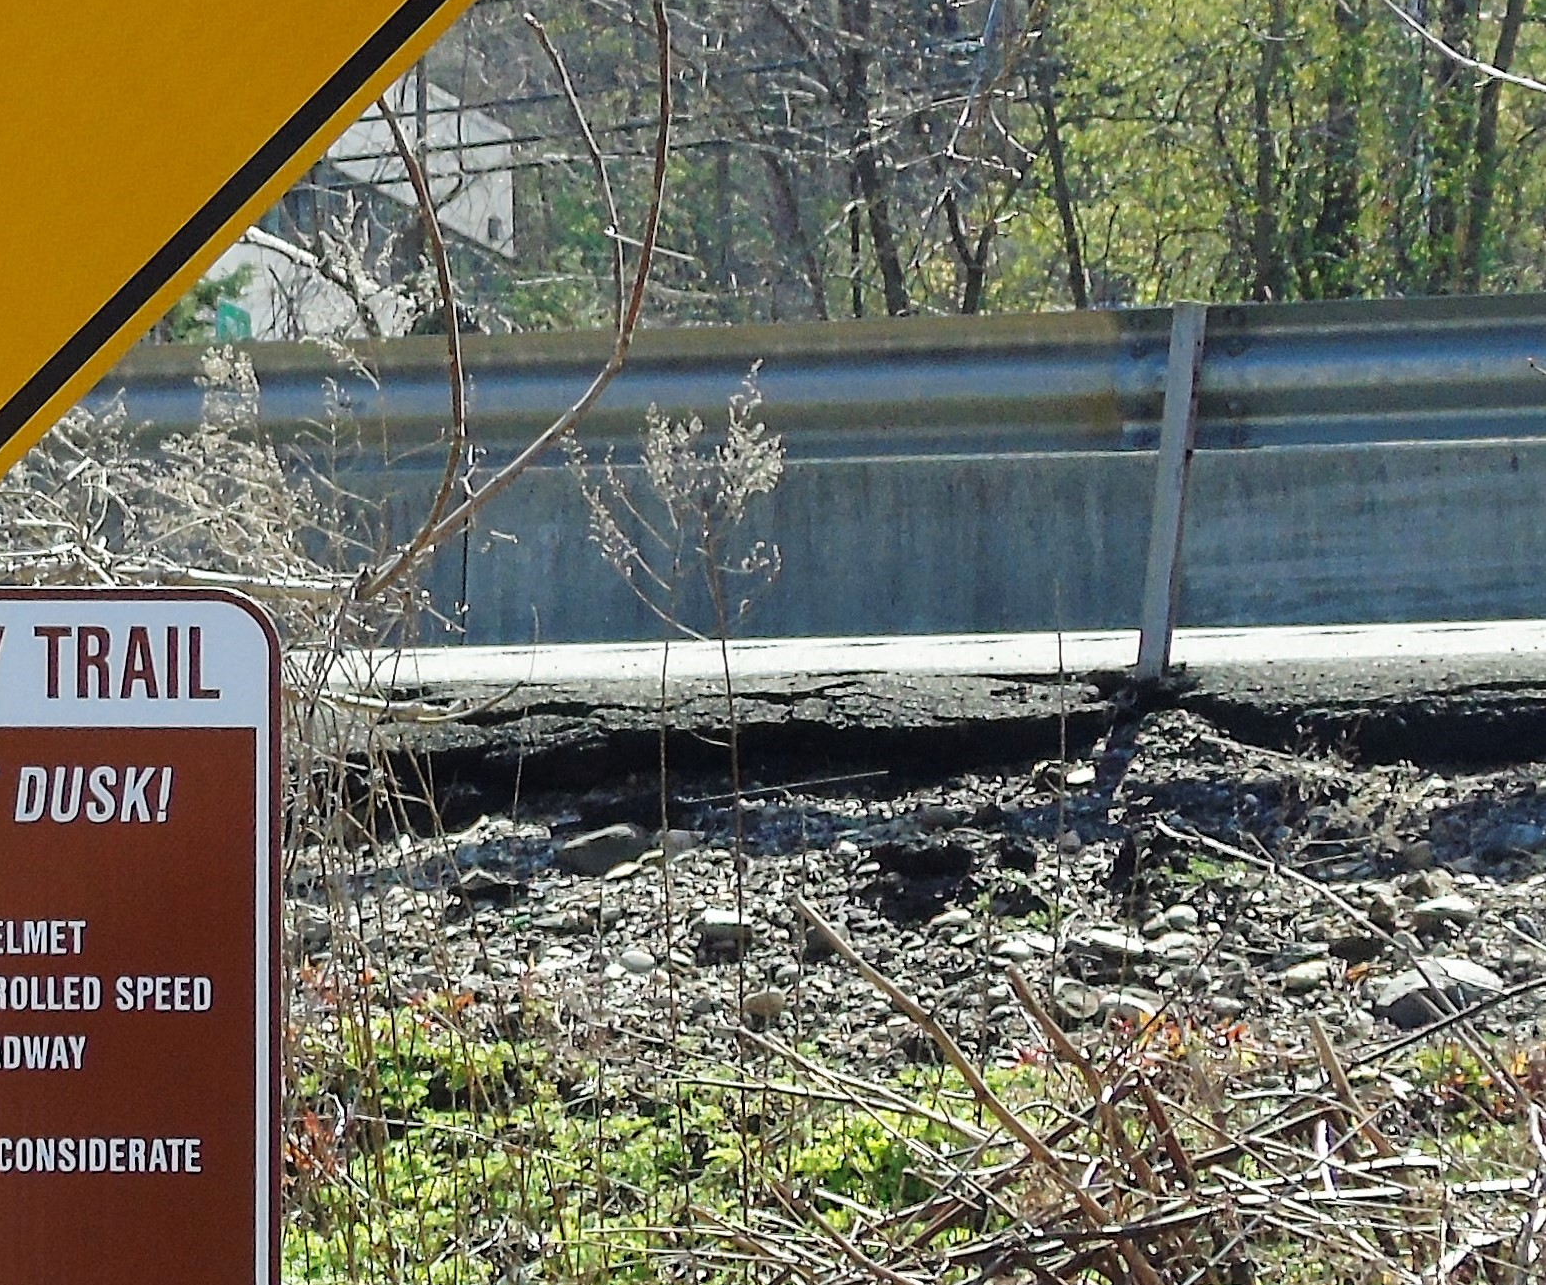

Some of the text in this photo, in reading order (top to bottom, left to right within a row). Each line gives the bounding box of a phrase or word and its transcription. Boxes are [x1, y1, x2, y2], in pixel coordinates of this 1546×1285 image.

[33, 625, 221, 700] TRAIL
[14, 765, 172, 823] DUSK!
[115, 976, 212, 1011] SPEED
